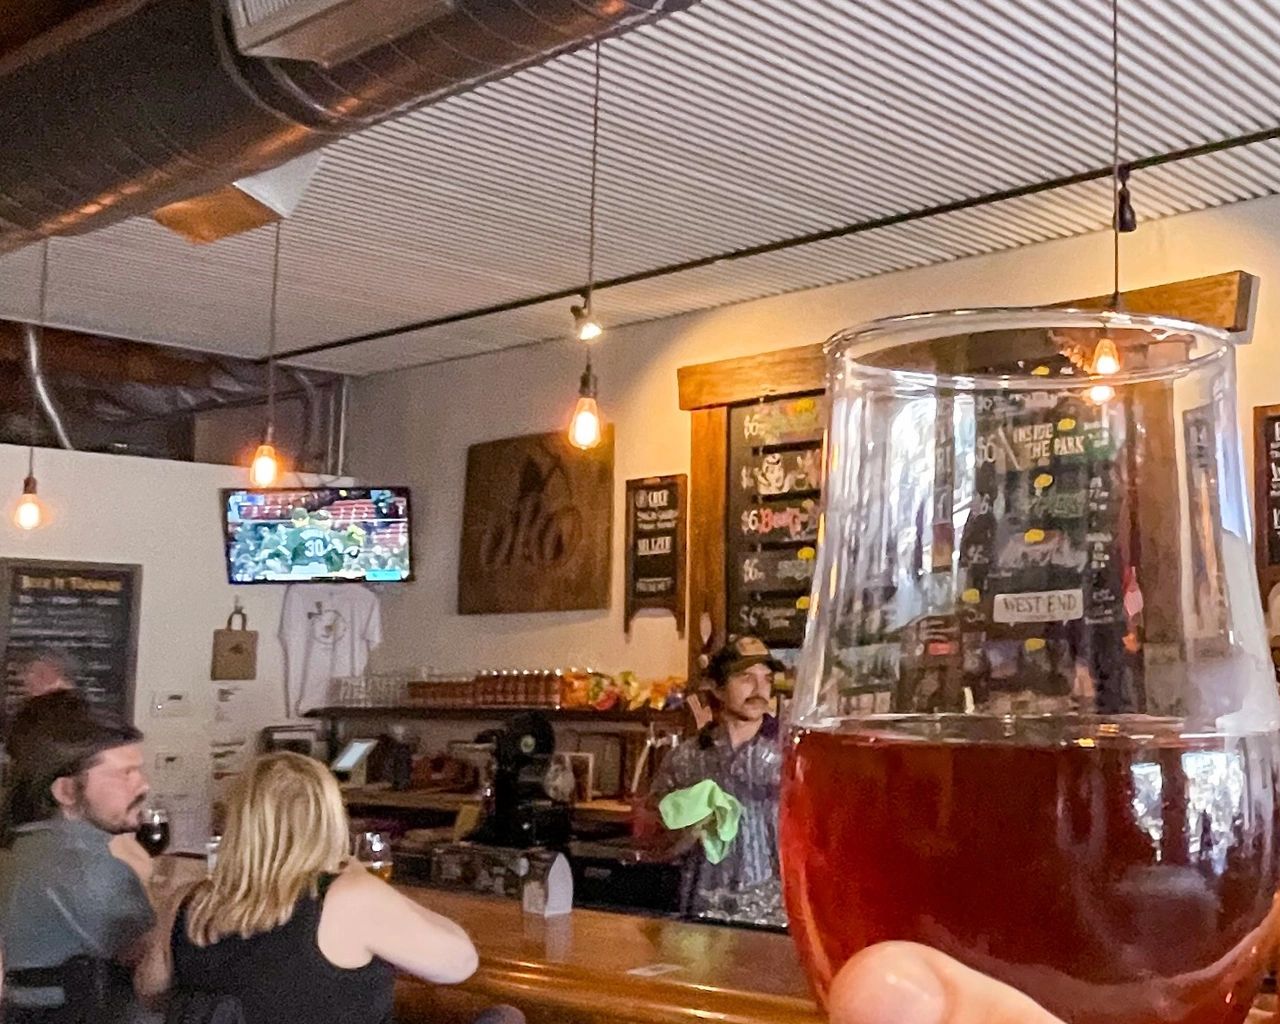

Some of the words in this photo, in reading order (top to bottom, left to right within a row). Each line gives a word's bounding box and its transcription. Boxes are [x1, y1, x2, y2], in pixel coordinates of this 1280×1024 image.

[1013, 423, 1053, 443] INSIDE
[1024, 440, 1051, 459] THE
[1054, 436, 1085, 456] PARK
[304, 538, 324, 558] 30
[1003, 597, 1042, 613] WEST
[1047, 593, 1077, 612] END
